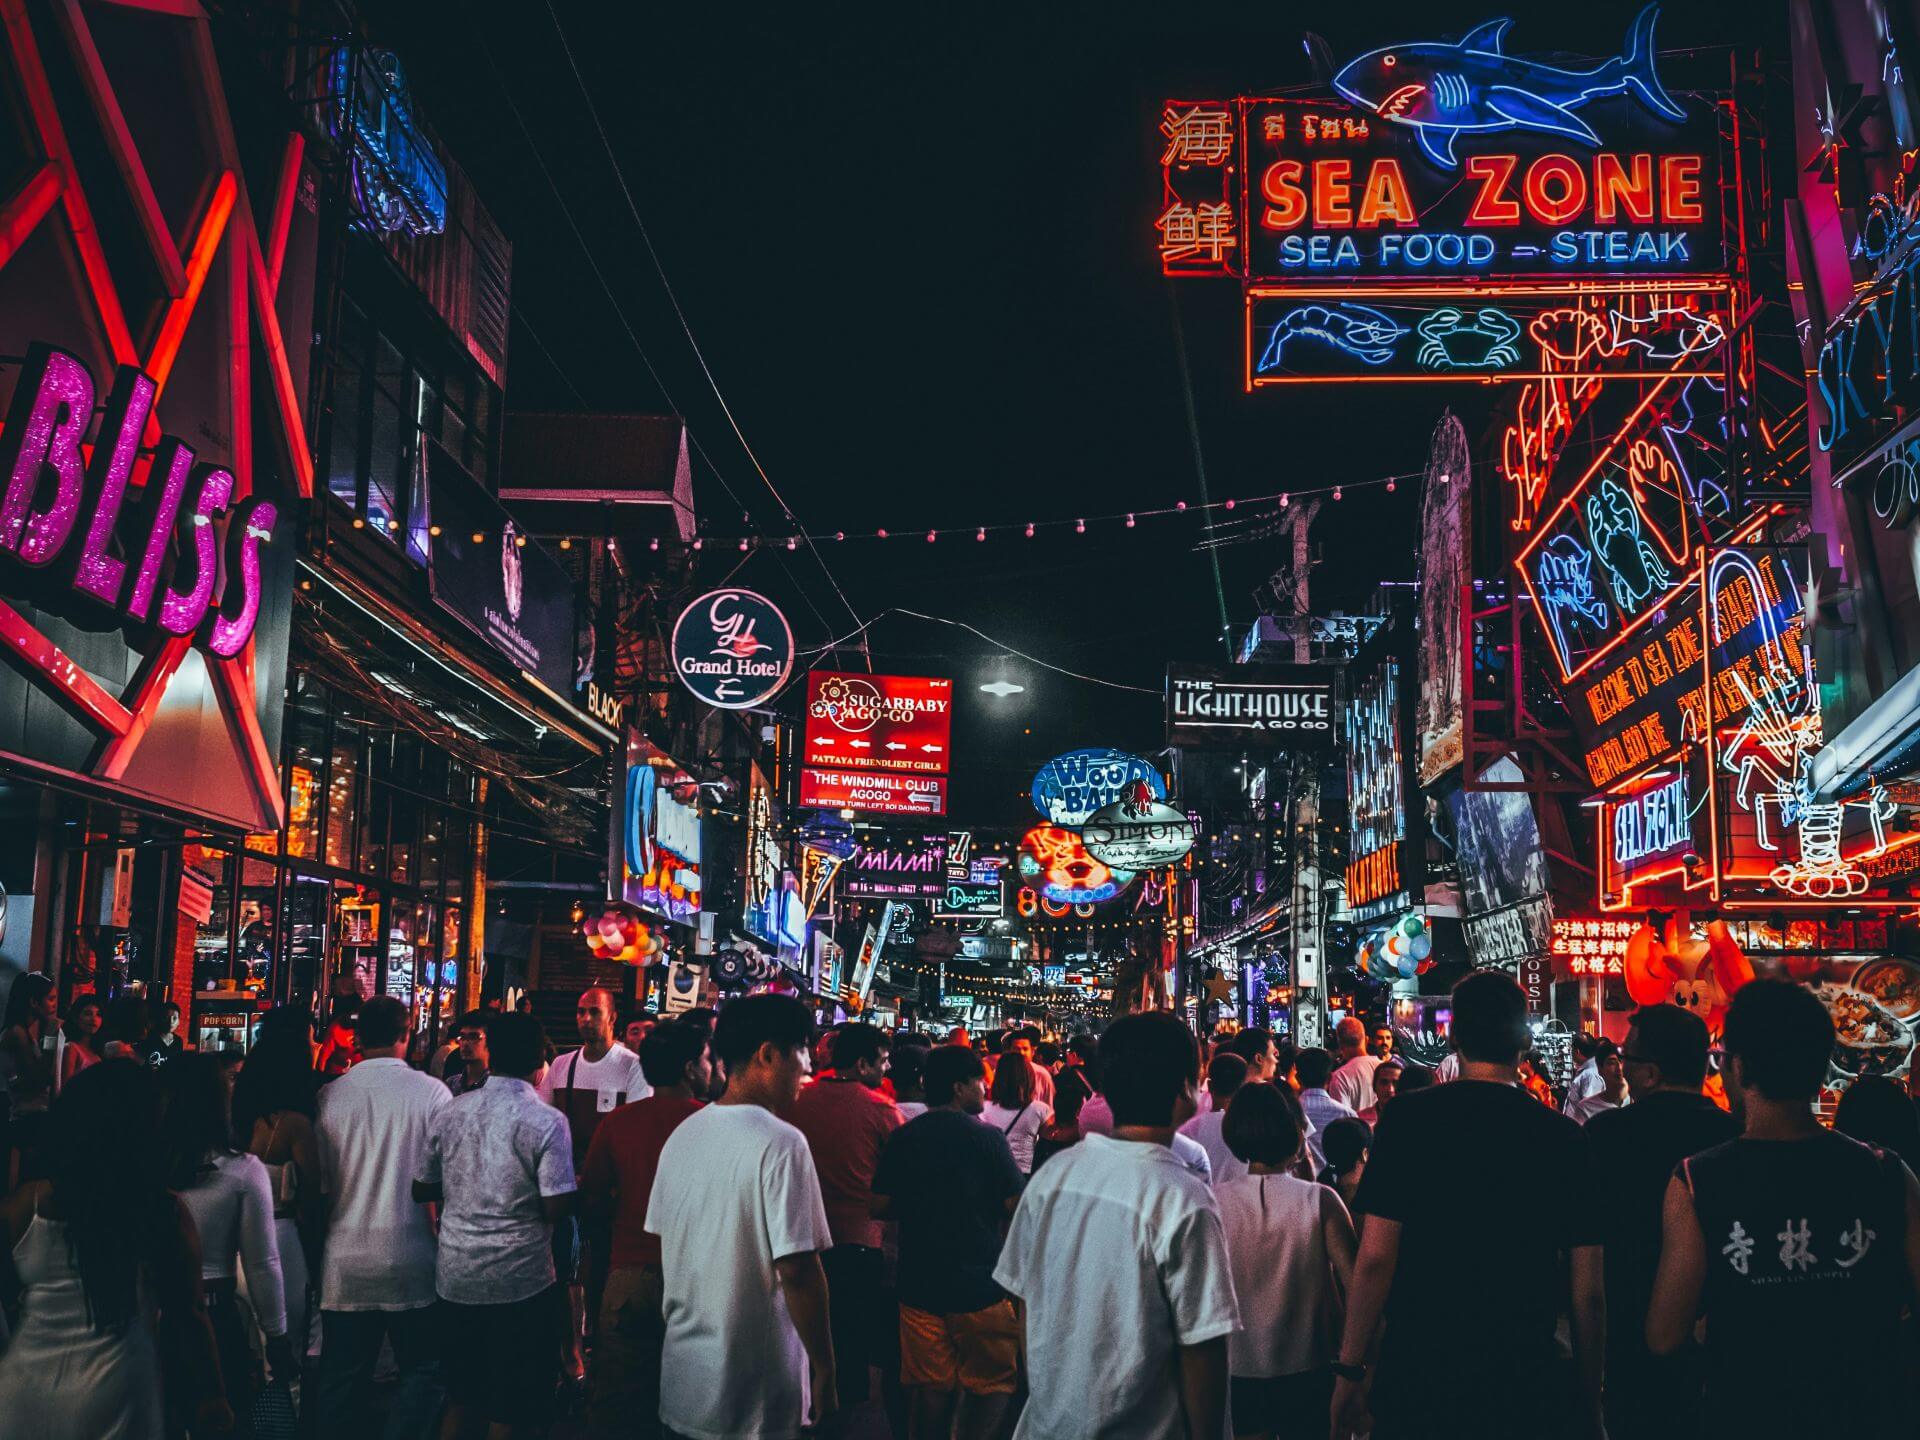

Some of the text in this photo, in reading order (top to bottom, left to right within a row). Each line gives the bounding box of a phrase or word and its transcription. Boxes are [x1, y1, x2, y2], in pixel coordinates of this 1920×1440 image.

[1261, 154, 1703, 230] SEA ZONE
[1279, 235, 1361, 267] SEA
[1380, 234, 1494, 266] FOOD
[1551, 232, 1689, 263] STEAK
[0, 350, 279, 657] BLISS
[681, 656, 782, 677] Grand Hotel
[1585, 668, 1636, 726] WELCOME
[1626, 656, 1648, 697] TO
[1642, 640, 1675, 687] SEA
[1665, 616, 1705, 674] ZONE
[1174, 680, 1213, 690] THE
[849, 694, 948, 712] SUGARBABY
[1174, 693, 1329, 717] LIGHTHOUSE
[845, 706, 914, 723] AGO-GO
[1268, 720, 1297, 729] GO
[1301, 721, 1329, 730] GO
[812, 754, 941, 770] PATTAYA FRIENDLIEST GIRLS
[815, 773, 938, 792] THE WINDMILL CLUB
[850, 789, 891, 801] AGOGO
[1614, 799, 1645, 864] SEA
[204, 1016, 243, 1026] POPCORN
